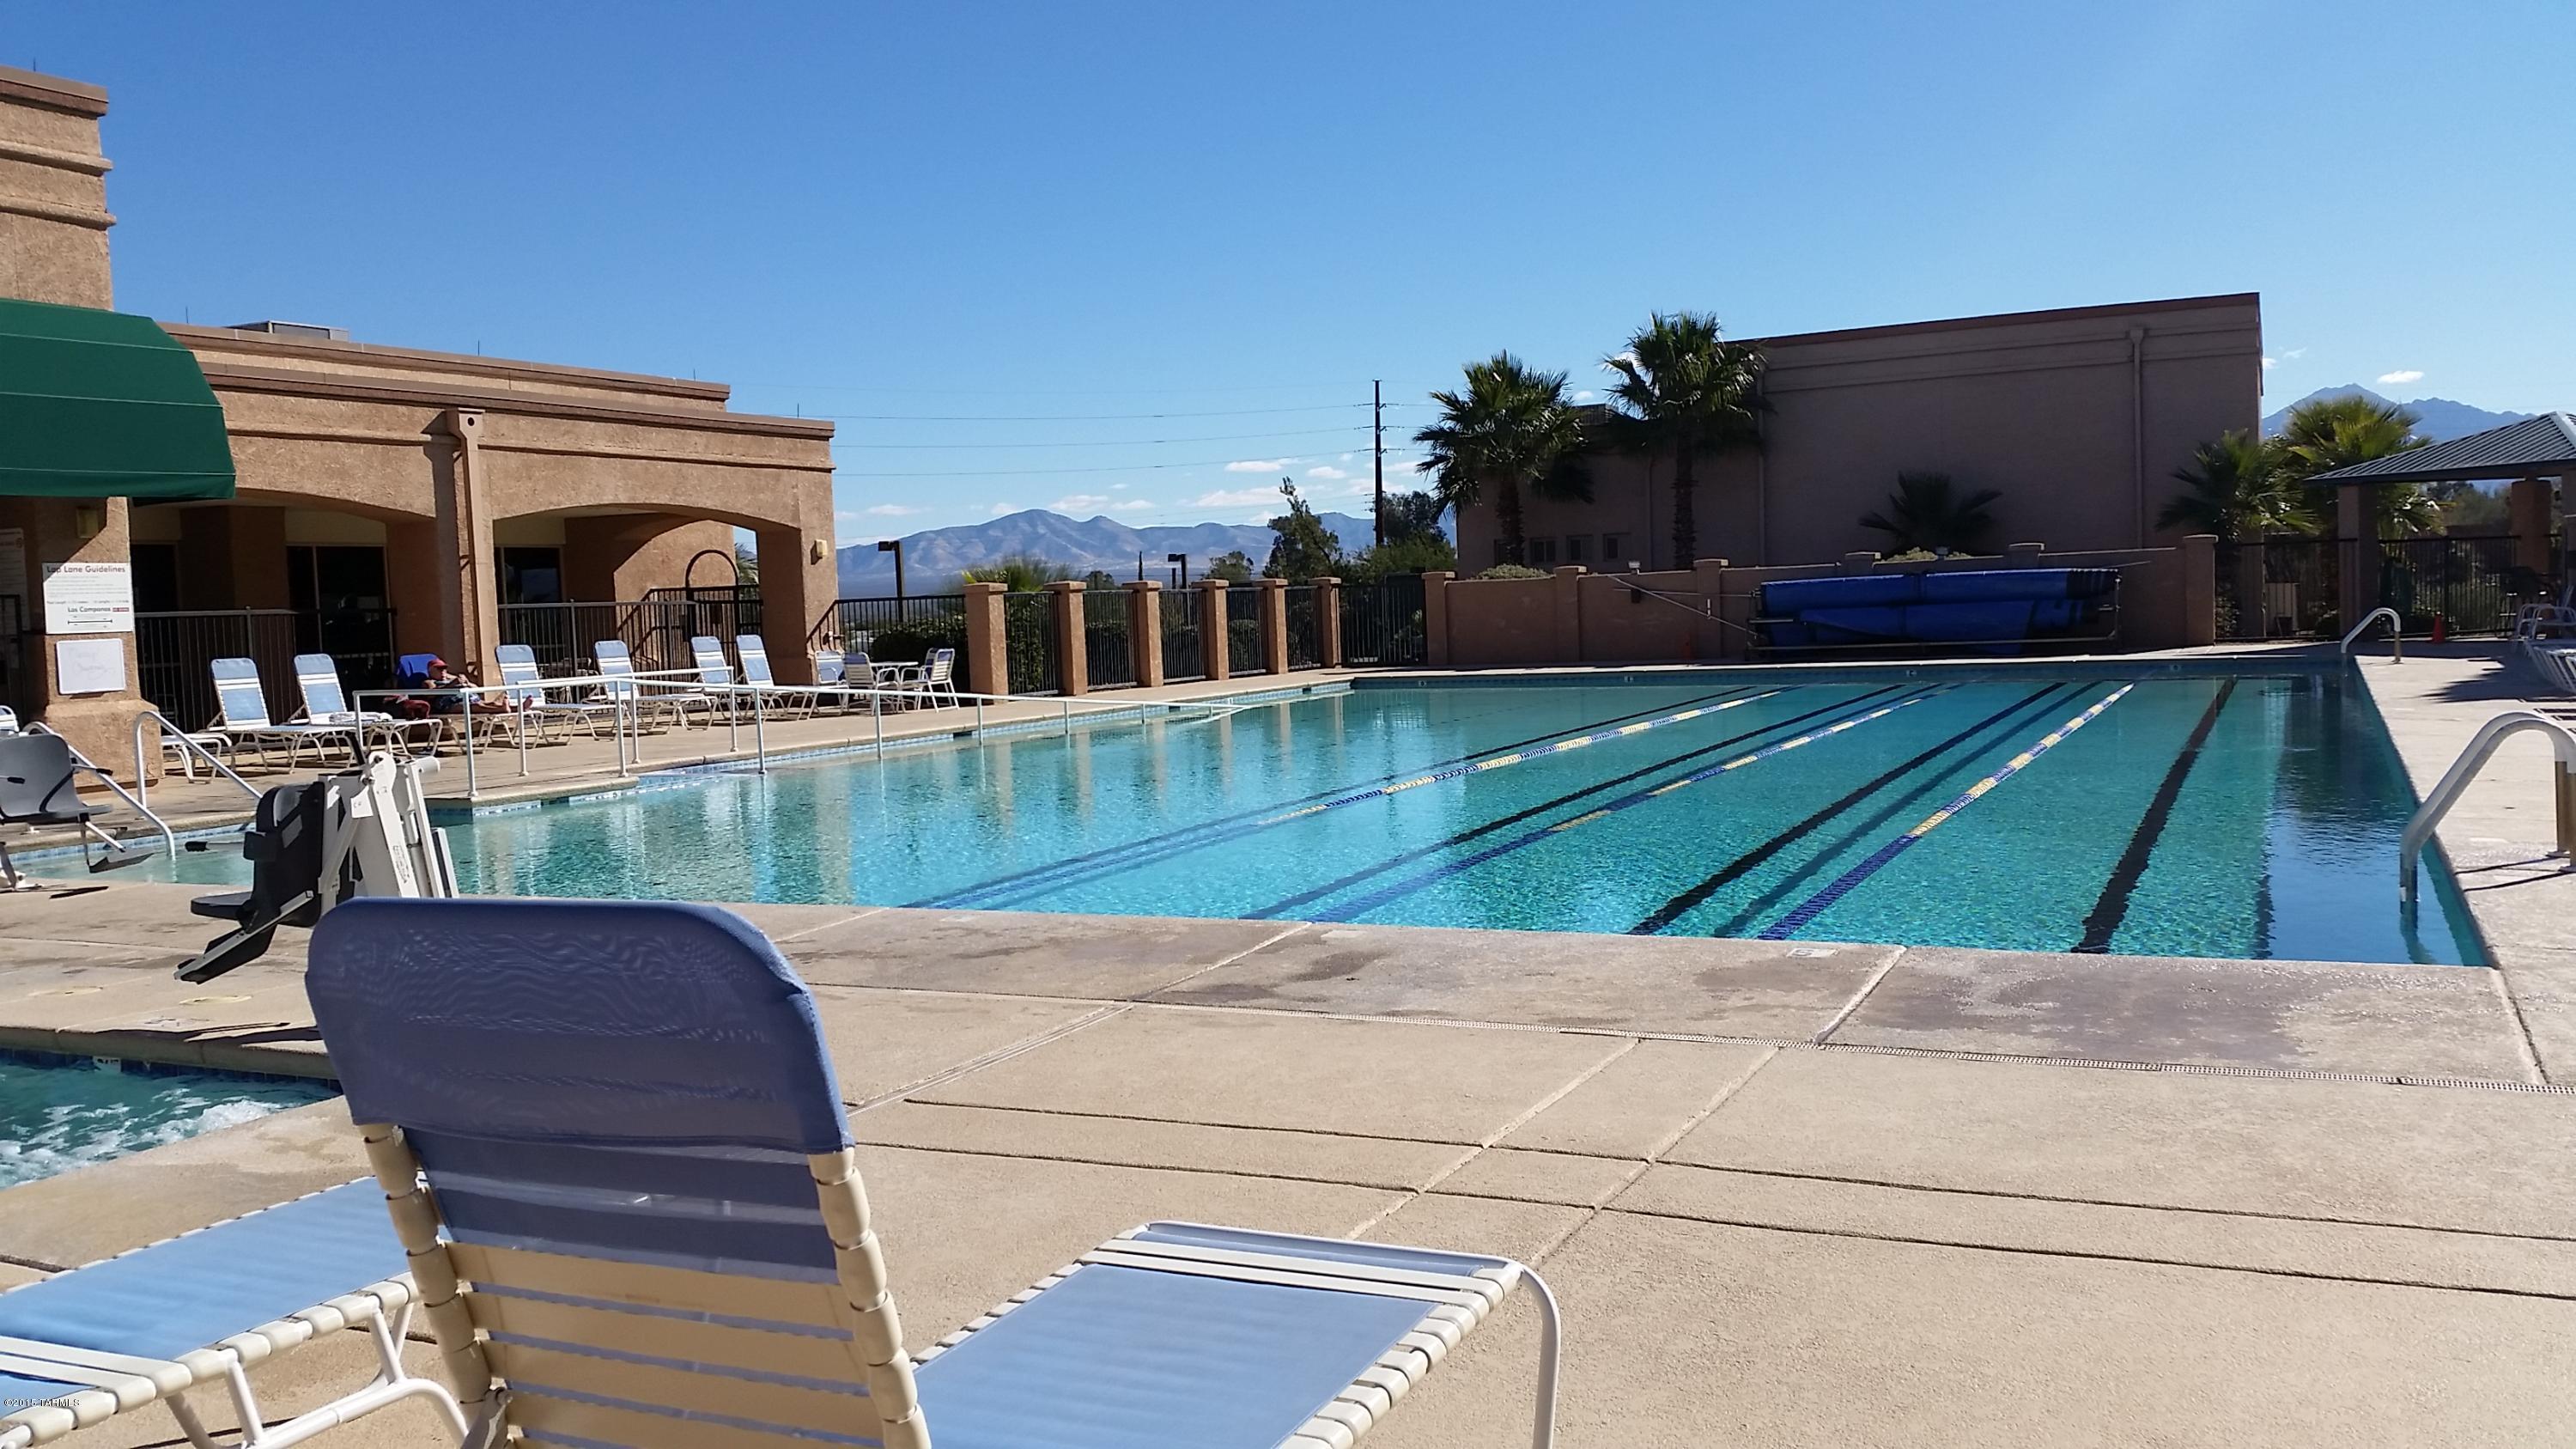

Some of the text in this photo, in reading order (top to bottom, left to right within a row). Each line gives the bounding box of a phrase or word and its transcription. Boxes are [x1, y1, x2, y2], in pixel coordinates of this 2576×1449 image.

[46, 565, 125, 575] Lap Lane Guidelines
